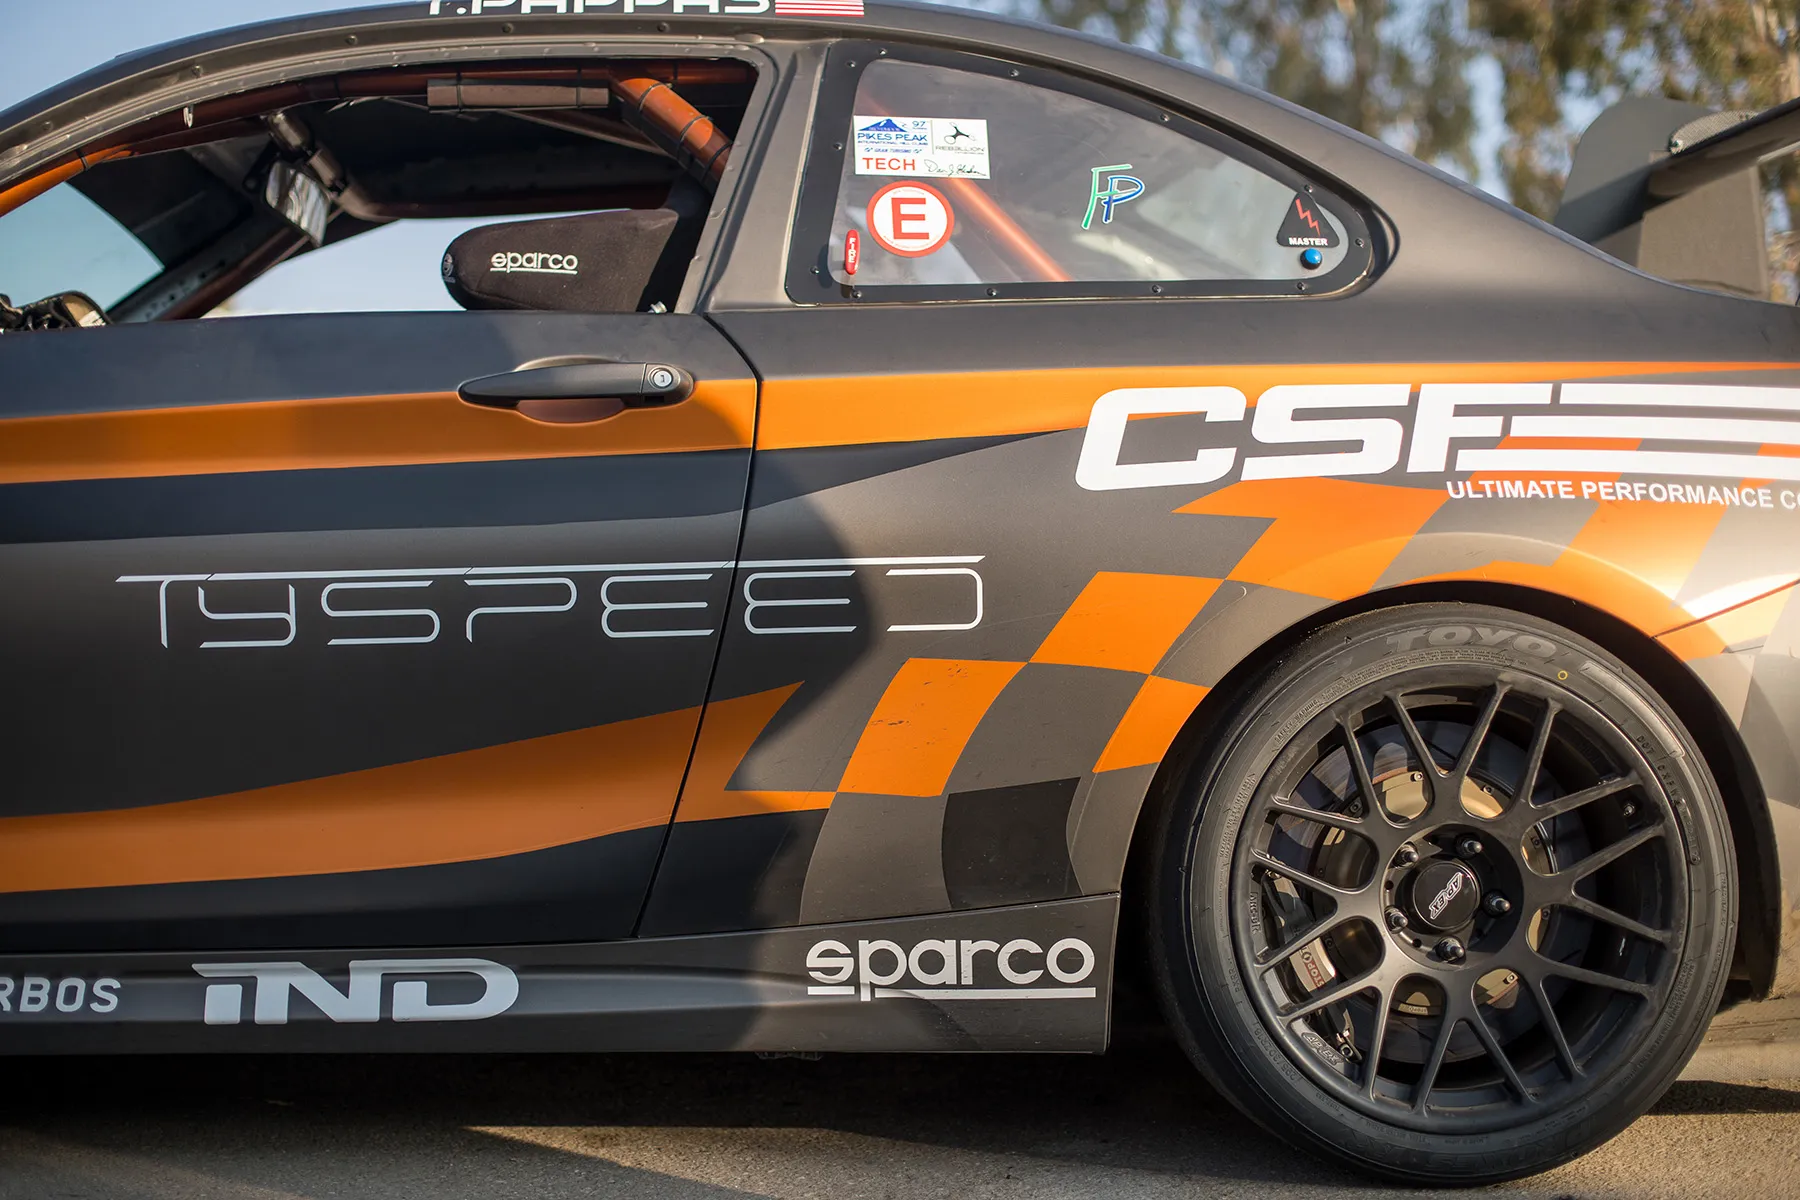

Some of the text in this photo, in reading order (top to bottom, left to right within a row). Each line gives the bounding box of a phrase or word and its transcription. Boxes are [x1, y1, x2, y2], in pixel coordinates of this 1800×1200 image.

[857, 132, 928, 142] PIKES PEAK
[862, 157, 917, 171] TECH
[891, 197, 930, 240] E
[847, 237, 857, 263] FIRE
[1288, 237, 1329, 246] MASTER
[490, 251, 579, 275] sparco
[1075, 383, 1554, 491] CSF
[1445, 480, 1577, 501] ULTIMATE
[1582, 481, 1775, 508] PERFORMANCE
[1386, 625, 1558, 658] TOYO
[805, 937, 1097, 1002] sparco
